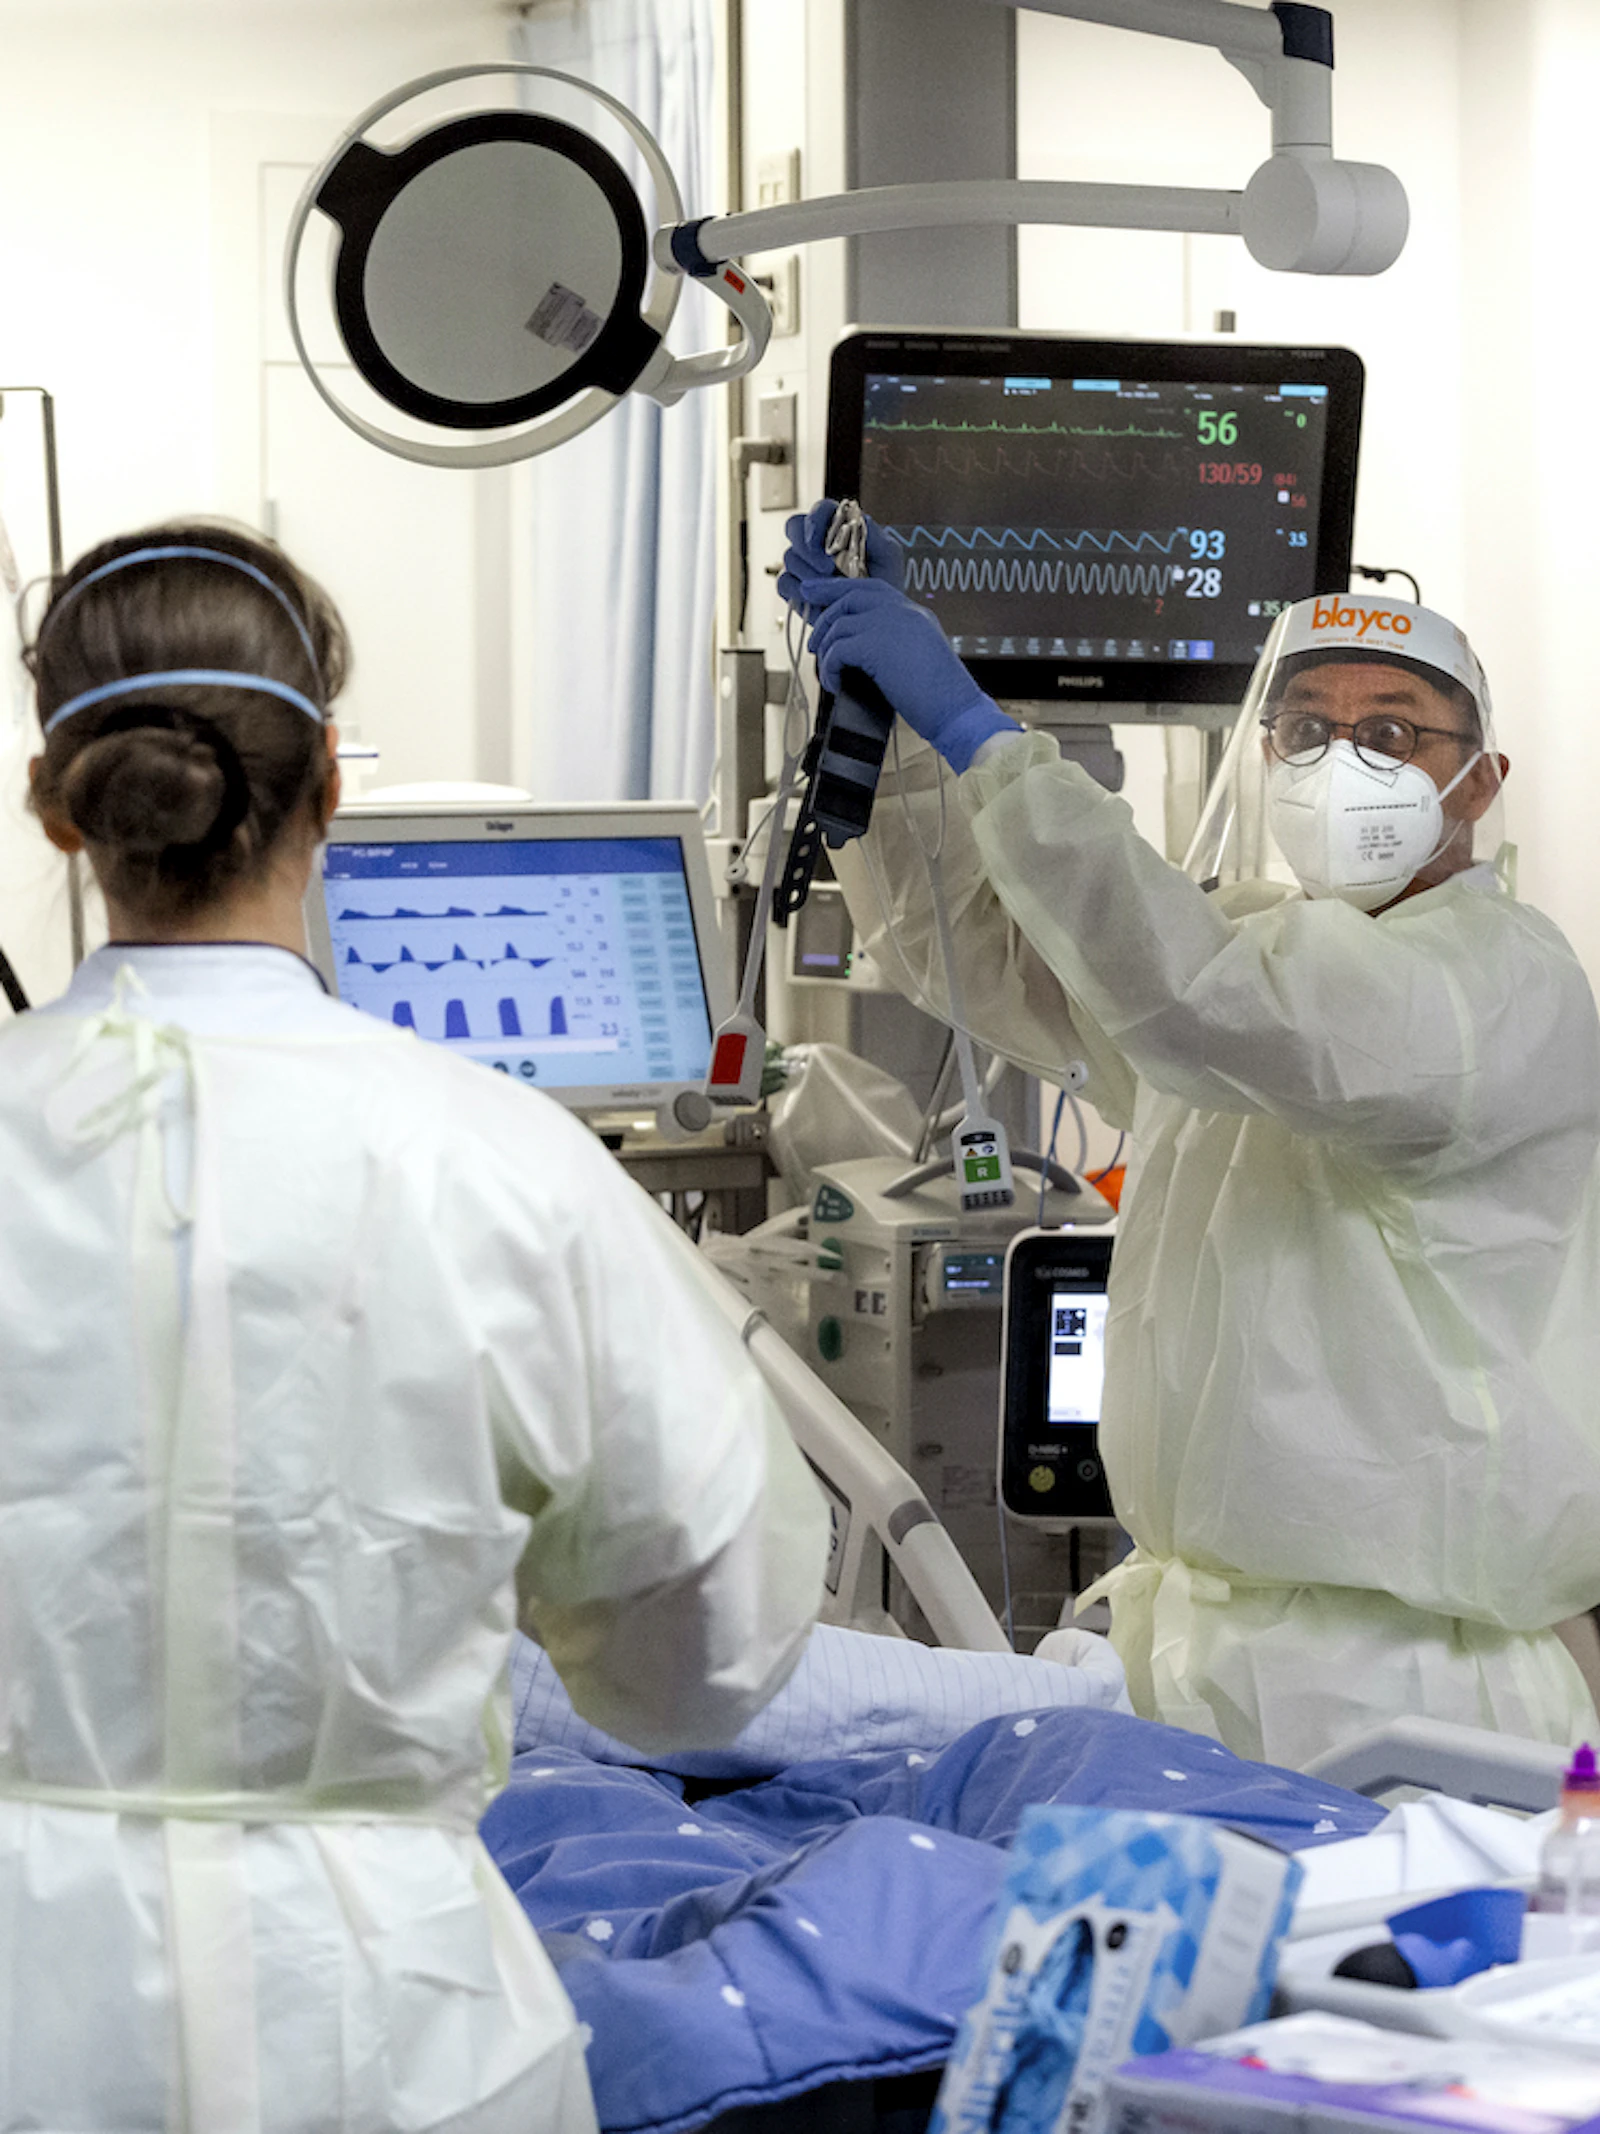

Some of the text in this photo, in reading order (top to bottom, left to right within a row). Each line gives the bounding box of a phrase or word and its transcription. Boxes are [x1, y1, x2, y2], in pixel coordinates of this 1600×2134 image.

[1197, 410, 1239, 446] 56
[1296, 412, 1308, 429] 0
[1198, 462, 1263, 486] 130/59
[1189, 529, 1227, 561] 93
[1185, 566, 1223, 598] 28
[1311, 596, 1412, 637] blayco
[1057, 675, 1104, 688] PHILIPS
